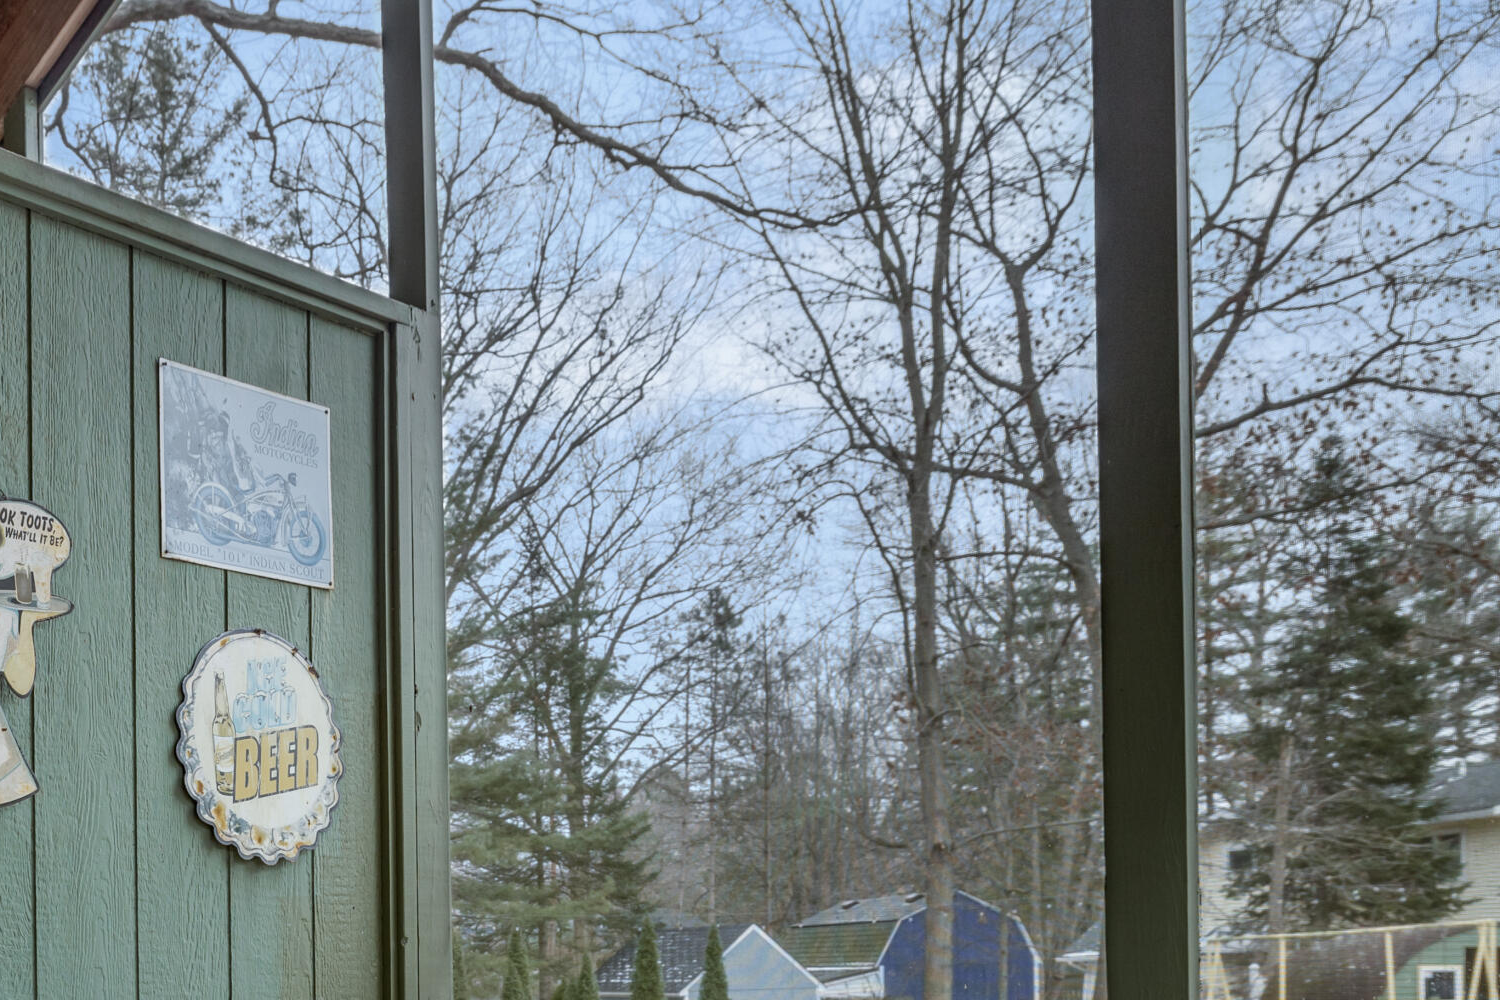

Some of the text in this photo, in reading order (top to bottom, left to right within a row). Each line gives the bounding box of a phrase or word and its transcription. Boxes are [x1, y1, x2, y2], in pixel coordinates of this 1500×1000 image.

[250, 401, 320, 458] Indian
[0, 507, 56, 535] OK TOOTS,
[5, 527, 65, 547] WHAT'LL IT BE?
[173, 540, 213, 558] MODEL
[250, 554, 288, 572] INDIAN
[289, 565, 325, 580] SCOUT
[233, 725, 319, 803] BEER
